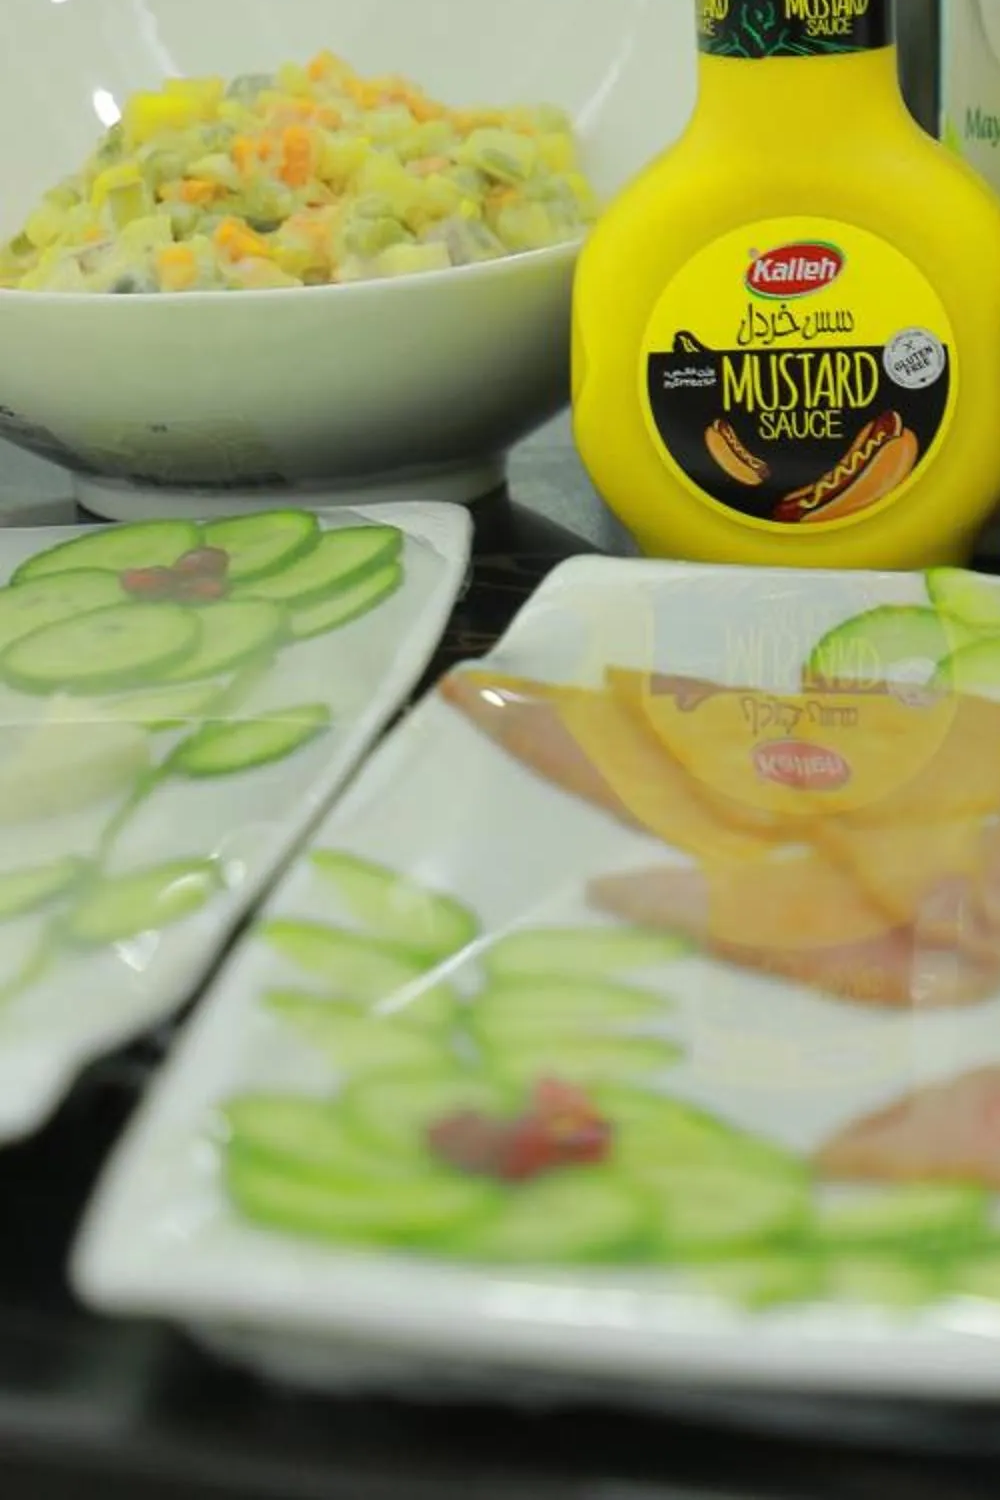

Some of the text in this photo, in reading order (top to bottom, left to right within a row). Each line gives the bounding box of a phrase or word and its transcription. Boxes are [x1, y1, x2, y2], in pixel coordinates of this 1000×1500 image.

[806, 17, 853, 37] SAUCE
[753, 256, 836, 283] Kalleh
[737, 303, 855, 346] سس خردل
[893, 345, 933, 372] GLUTEN
[905, 357, 931, 377] FREE
[722, 351, 879, 412] MUSTARD
[759, 409, 842, 438] SAUCE
